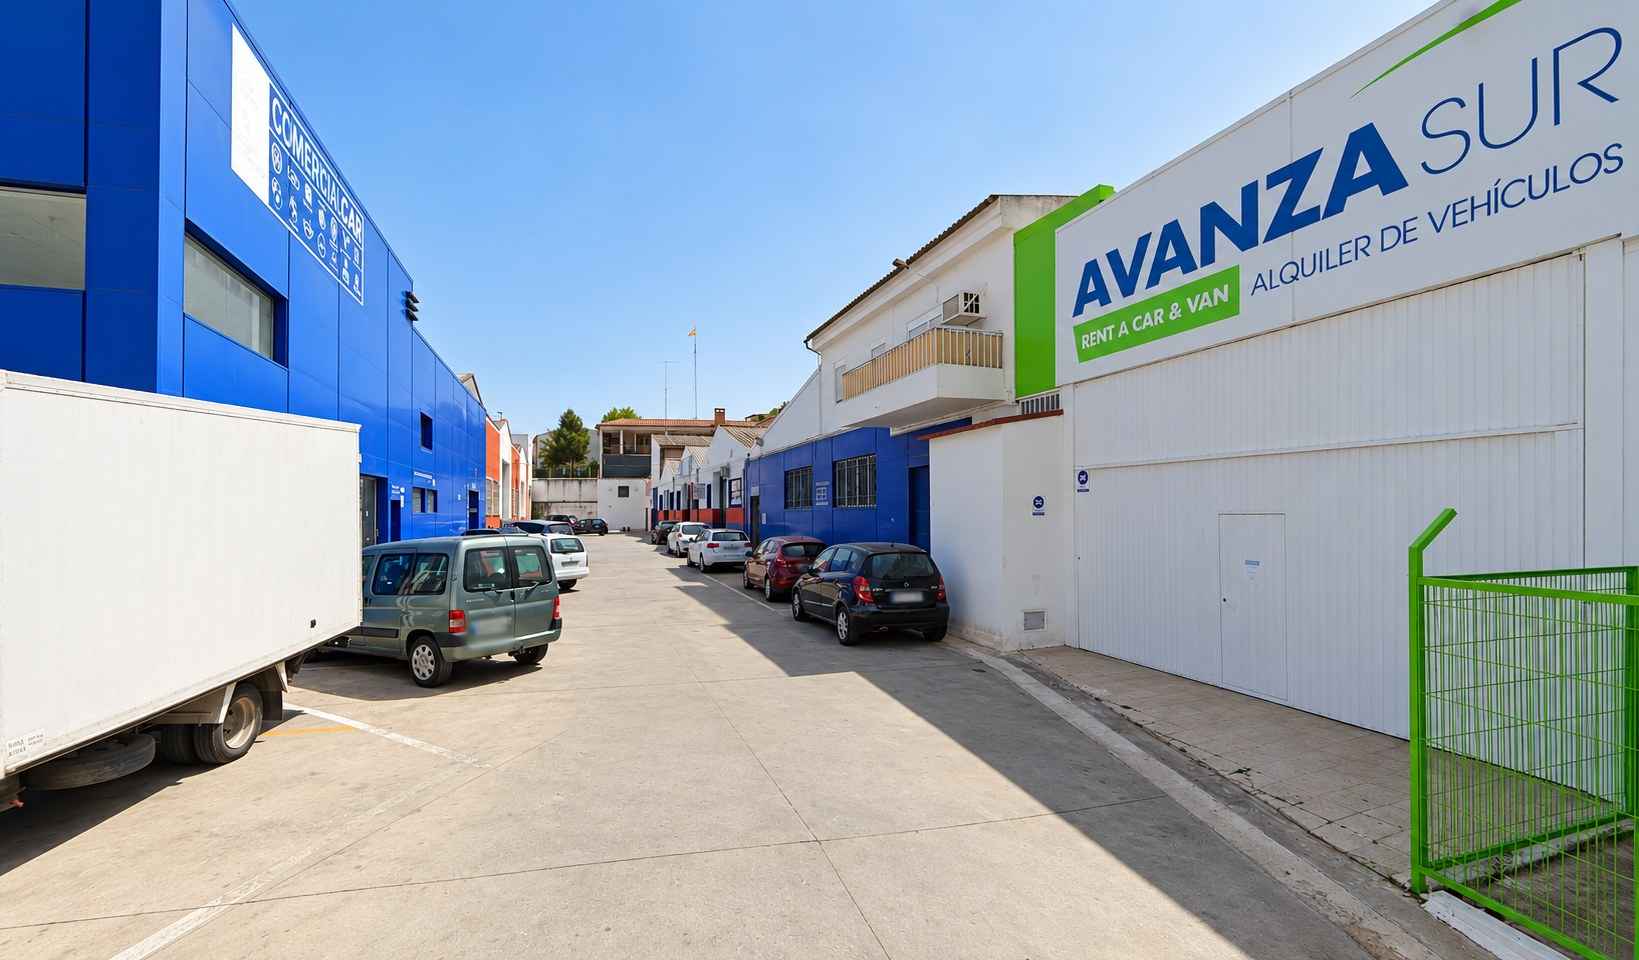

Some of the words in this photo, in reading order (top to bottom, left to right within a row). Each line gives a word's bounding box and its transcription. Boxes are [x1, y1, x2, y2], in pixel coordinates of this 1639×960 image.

[1072, 122, 1409, 318] AVANZA
[1420, 26, 1623, 175] SUR
[1250, 235, 1371, 296] ALQUILER
[1380, 216, 1419, 253] DE
[1427, 143, 1624, 234] VEHÍCULOS
[1080, 323, 1117, 350] RENT
[1117, 319, 1130, 338] A
[1132, 308, 1164, 332] CAR
[1169, 301, 1183, 320] &
[1186, 284, 1229, 313] VAN
